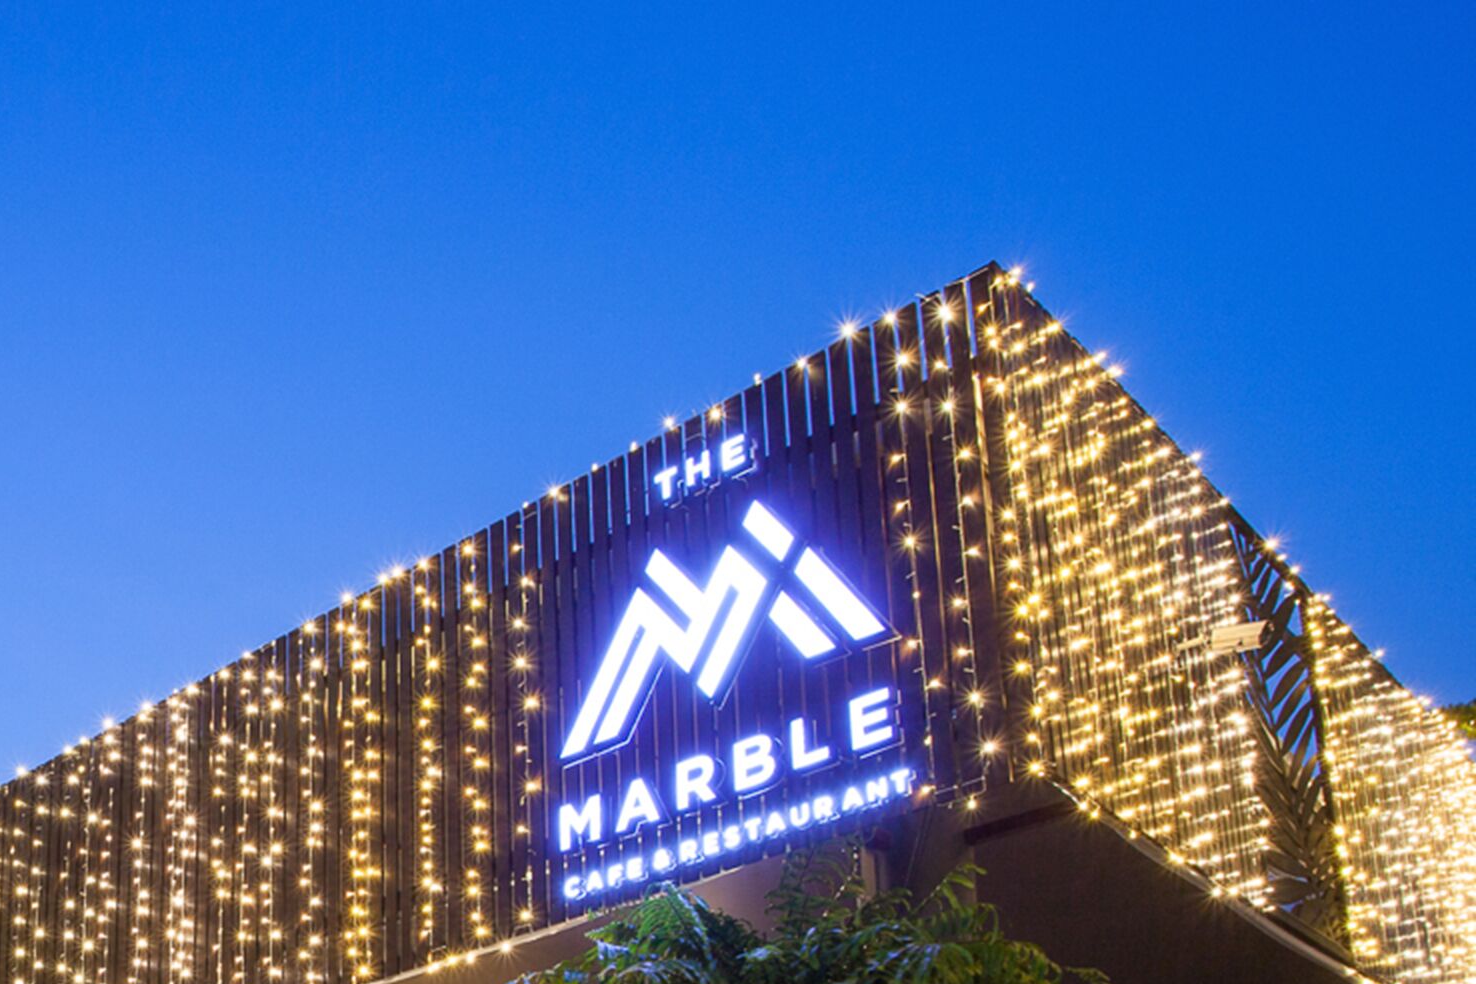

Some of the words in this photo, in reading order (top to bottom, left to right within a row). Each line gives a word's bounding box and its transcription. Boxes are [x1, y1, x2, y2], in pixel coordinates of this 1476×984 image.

[653, 433, 746, 500] THE
[559, 687, 894, 852] MARBLE
[563, 856, 644, 899] CAFE
[652, 847, 675, 872] &
[677, 767, 912, 864] RESTAURANT
